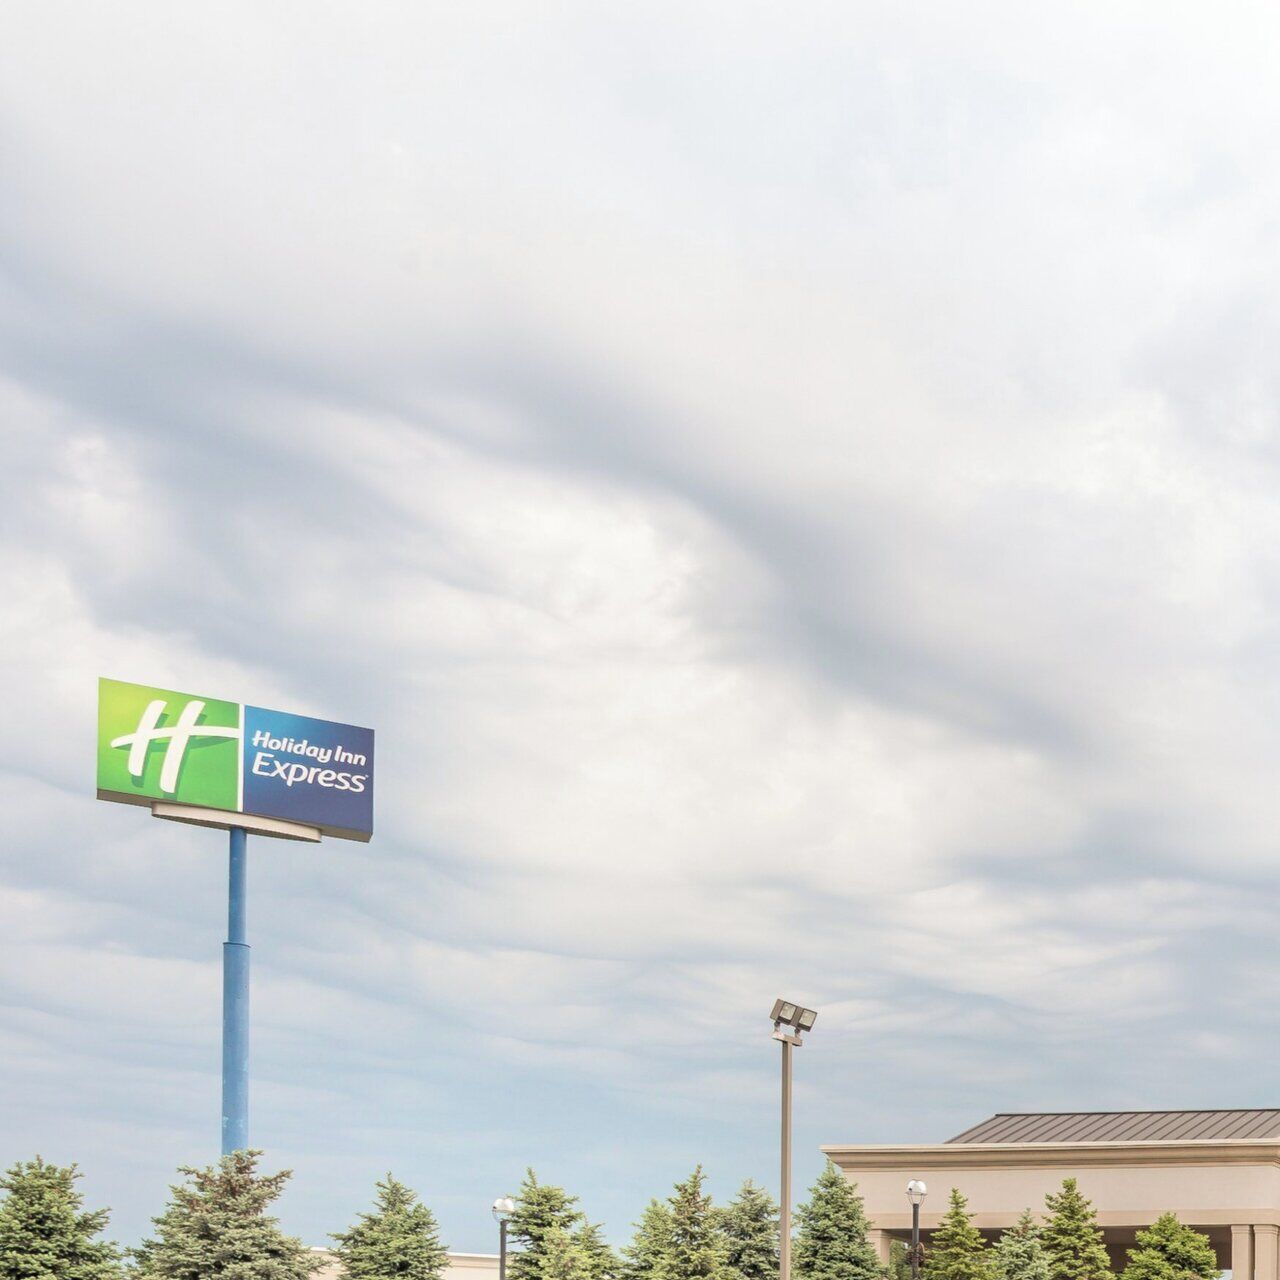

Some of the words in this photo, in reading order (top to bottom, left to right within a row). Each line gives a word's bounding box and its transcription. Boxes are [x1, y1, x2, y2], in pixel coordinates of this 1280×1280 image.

[251, 730, 332, 763] Holiday
[334, 745, 367, 766] Inn
[251, 751, 366, 793] Express
